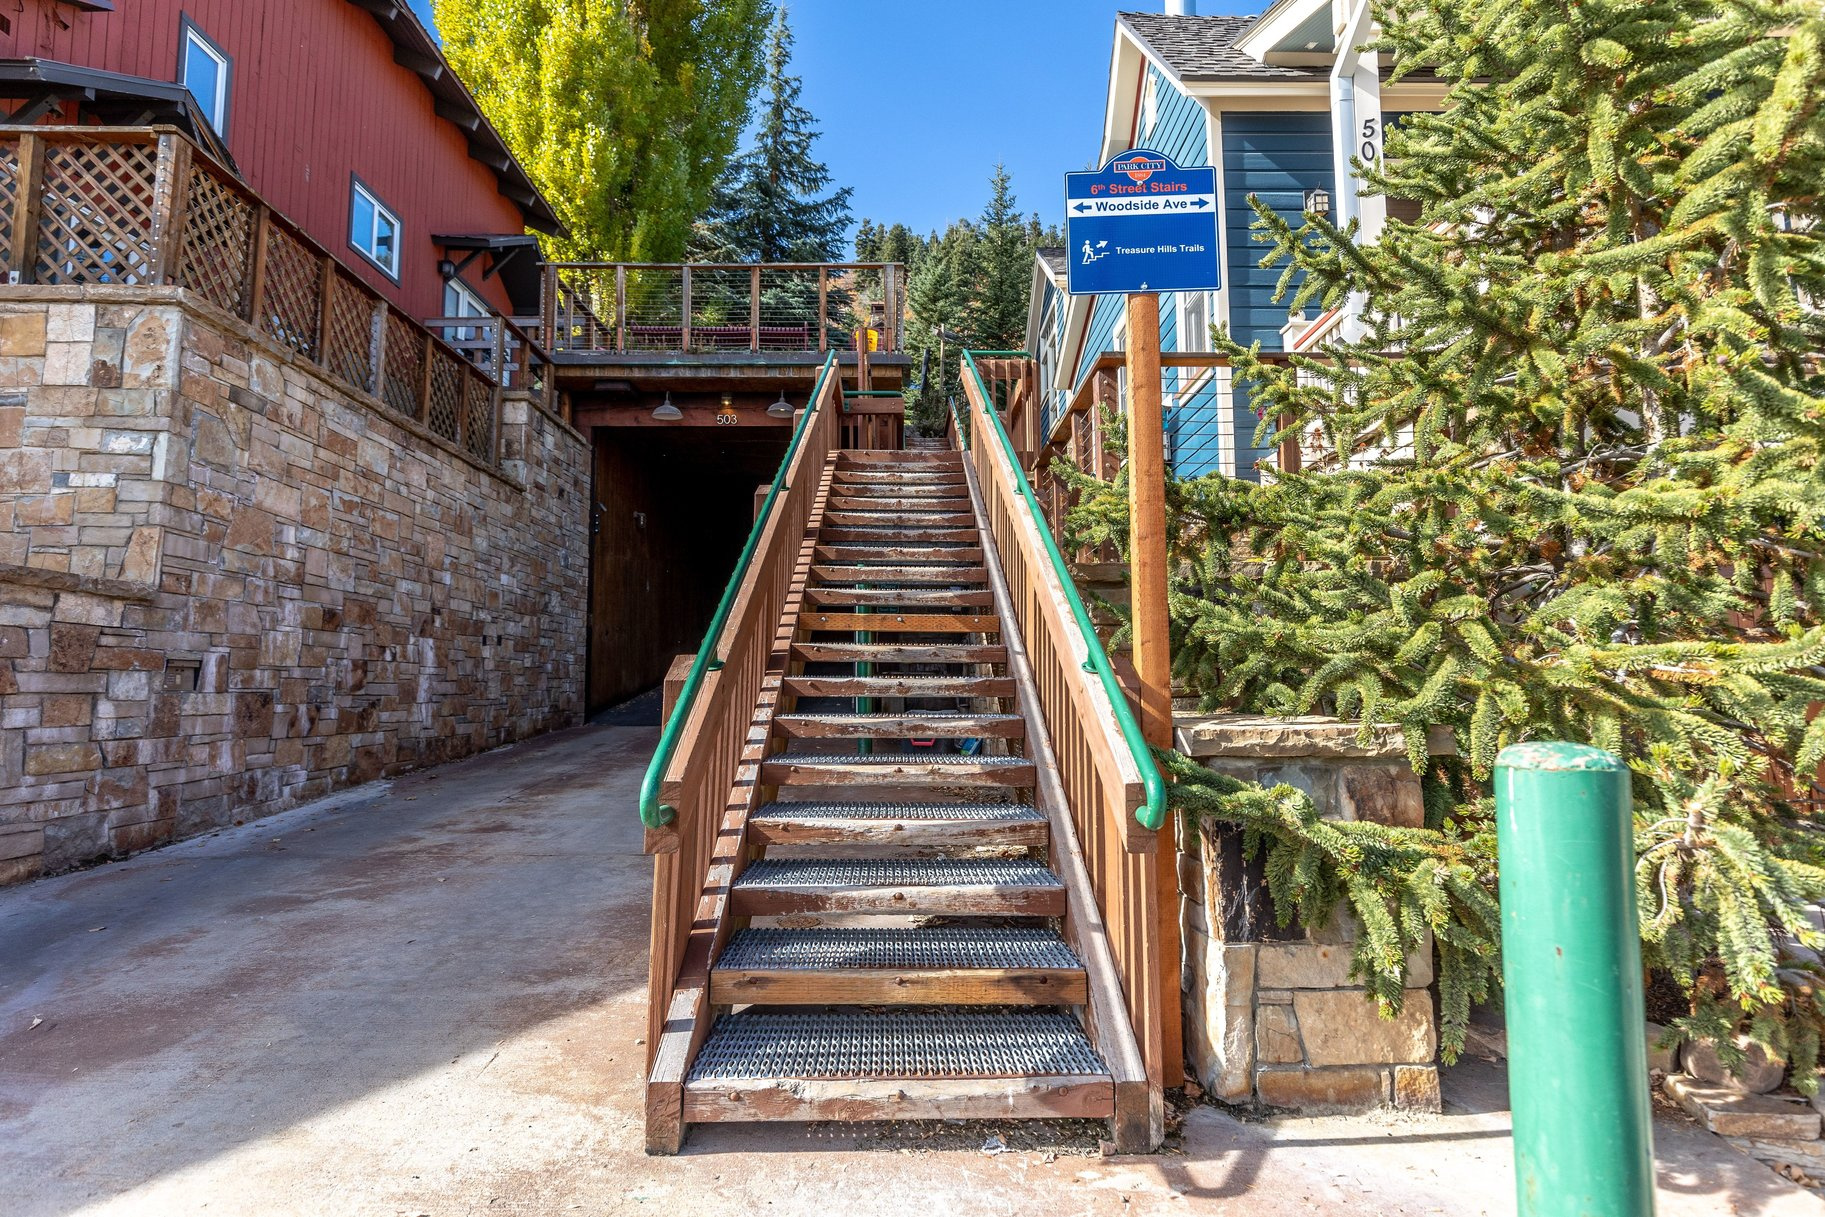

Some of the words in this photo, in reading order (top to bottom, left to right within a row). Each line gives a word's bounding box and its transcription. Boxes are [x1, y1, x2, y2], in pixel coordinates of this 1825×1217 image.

[1117, 163, 1139, 171] PARK
[1141, 162, 1162, 170] CITY
[1090, 184, 1106, 195] 6th
[1109, 183, 1147, 194] Street
[1151, 182, 1188, 193] Stairs
[1096, 200, 1159, 212] Woodside
[1163, 199, 1188, 210] Ave
[1115, 246, 1155, 255] Treasure
[1157, 245, 1177, 253] Hills
[1179, 244, 1205, 252] Trails
[716, 414, 738, 425] 503
